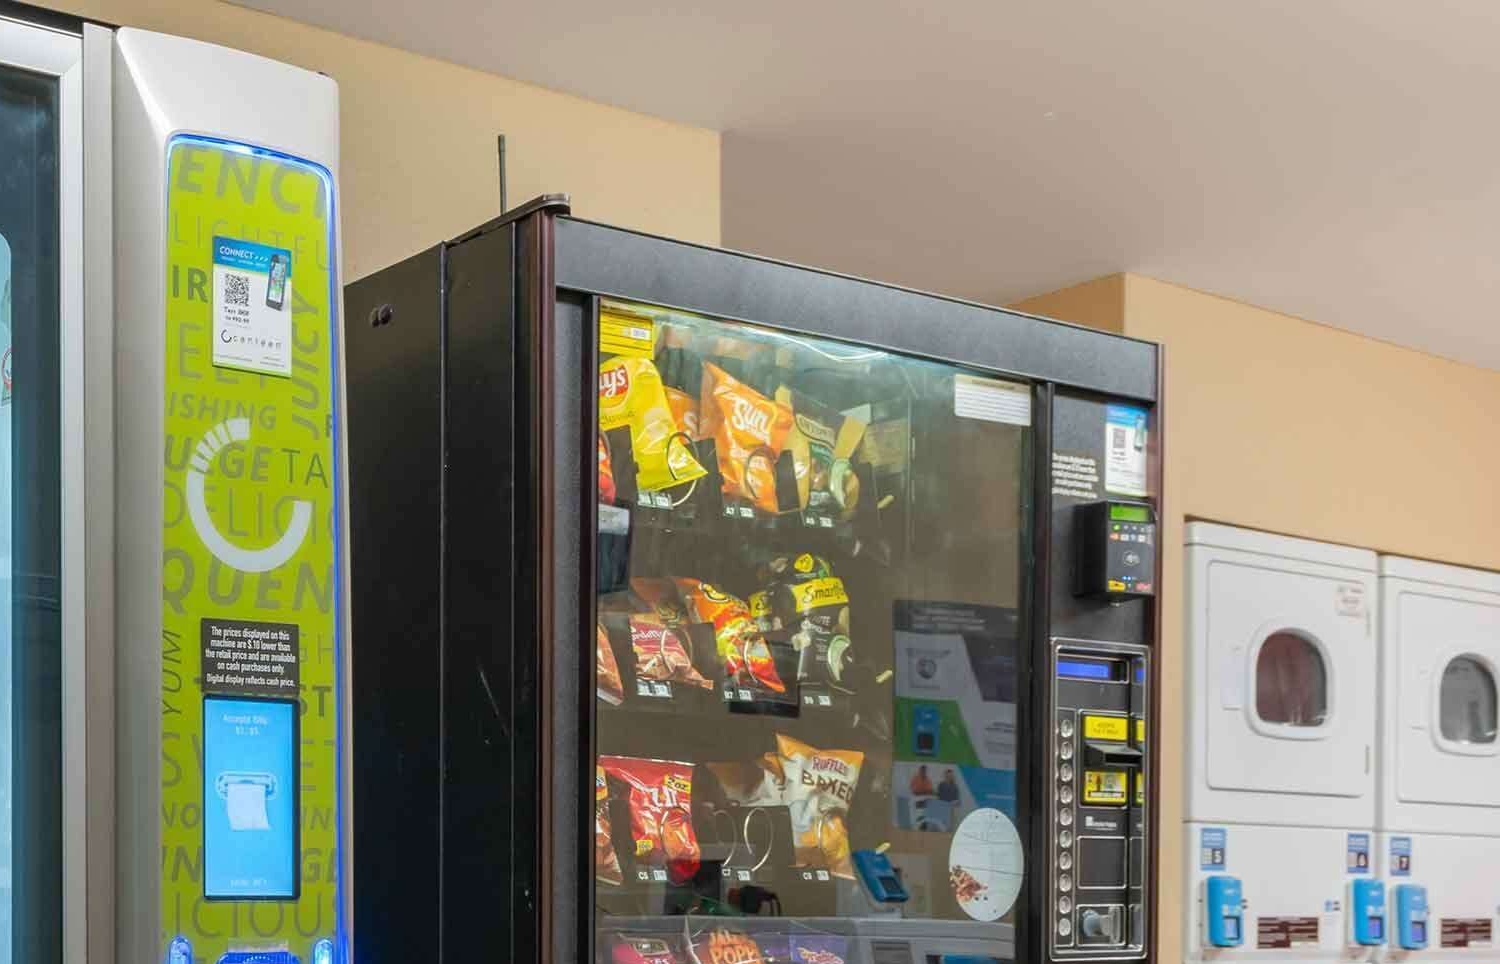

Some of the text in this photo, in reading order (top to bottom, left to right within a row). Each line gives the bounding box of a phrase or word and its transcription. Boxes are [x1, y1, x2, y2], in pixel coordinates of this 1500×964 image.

[219, 245, 254, 260] CONNECT
[211, 625, 290, 640] The prices displayed on this
[210, 639, 236, 648] machine
[261, 641, 277, 651] lower
[278, 642, 291, 652] than
[205, 648, 296, 664] the retail price and are available
[217, 662, 225, 670] on
[226, 661, 241, 671] cash
[241, 662, 271, 674] purchases
[206, 673, 224, 685] Digital
[225, 675, 244, 687] display
[266, 677, 280, 686] cash
[801, 769, 854, 801] BAKED
